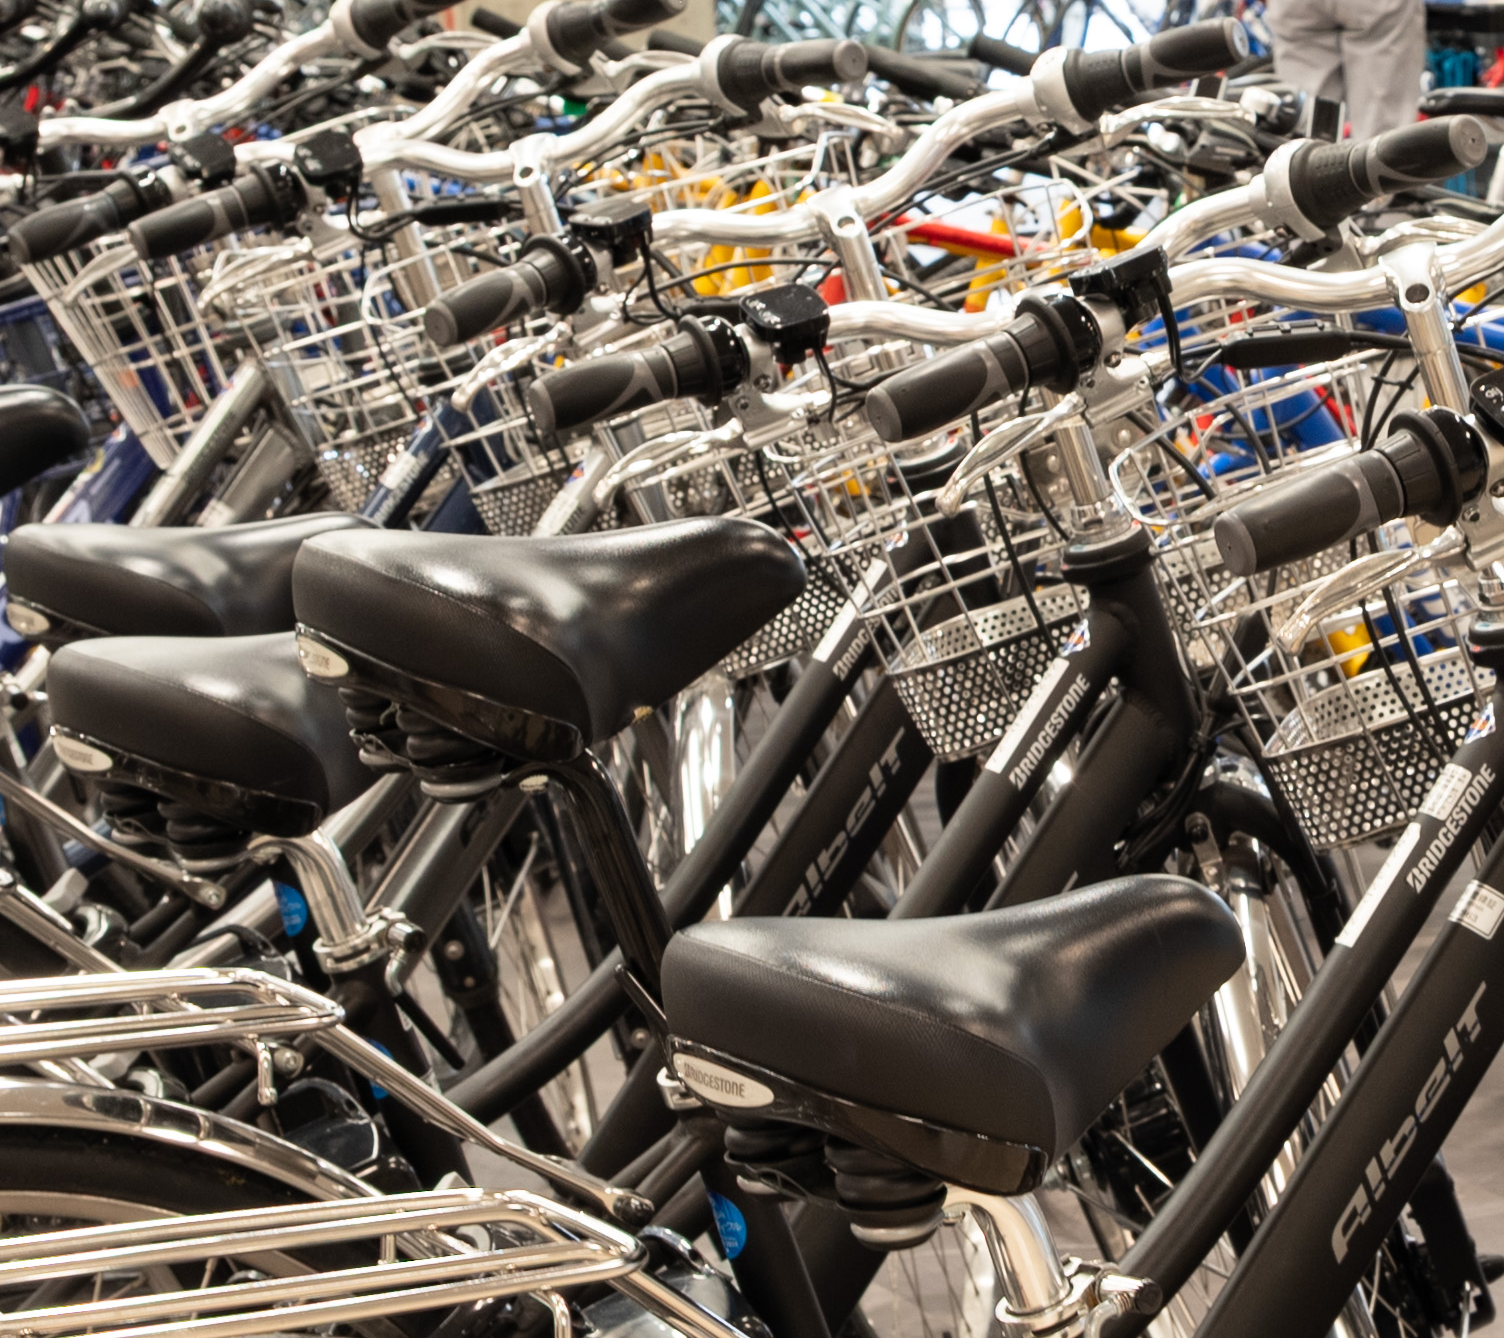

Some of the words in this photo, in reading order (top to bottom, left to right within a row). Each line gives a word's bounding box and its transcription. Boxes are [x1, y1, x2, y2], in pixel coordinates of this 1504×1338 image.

[1009, 672, 1090, 790] BRIDGESTONE
[1406, 762, 1497, 893] BRIDGESTONE
[683, 1062, 747, 1099] BRIDGESTONE
